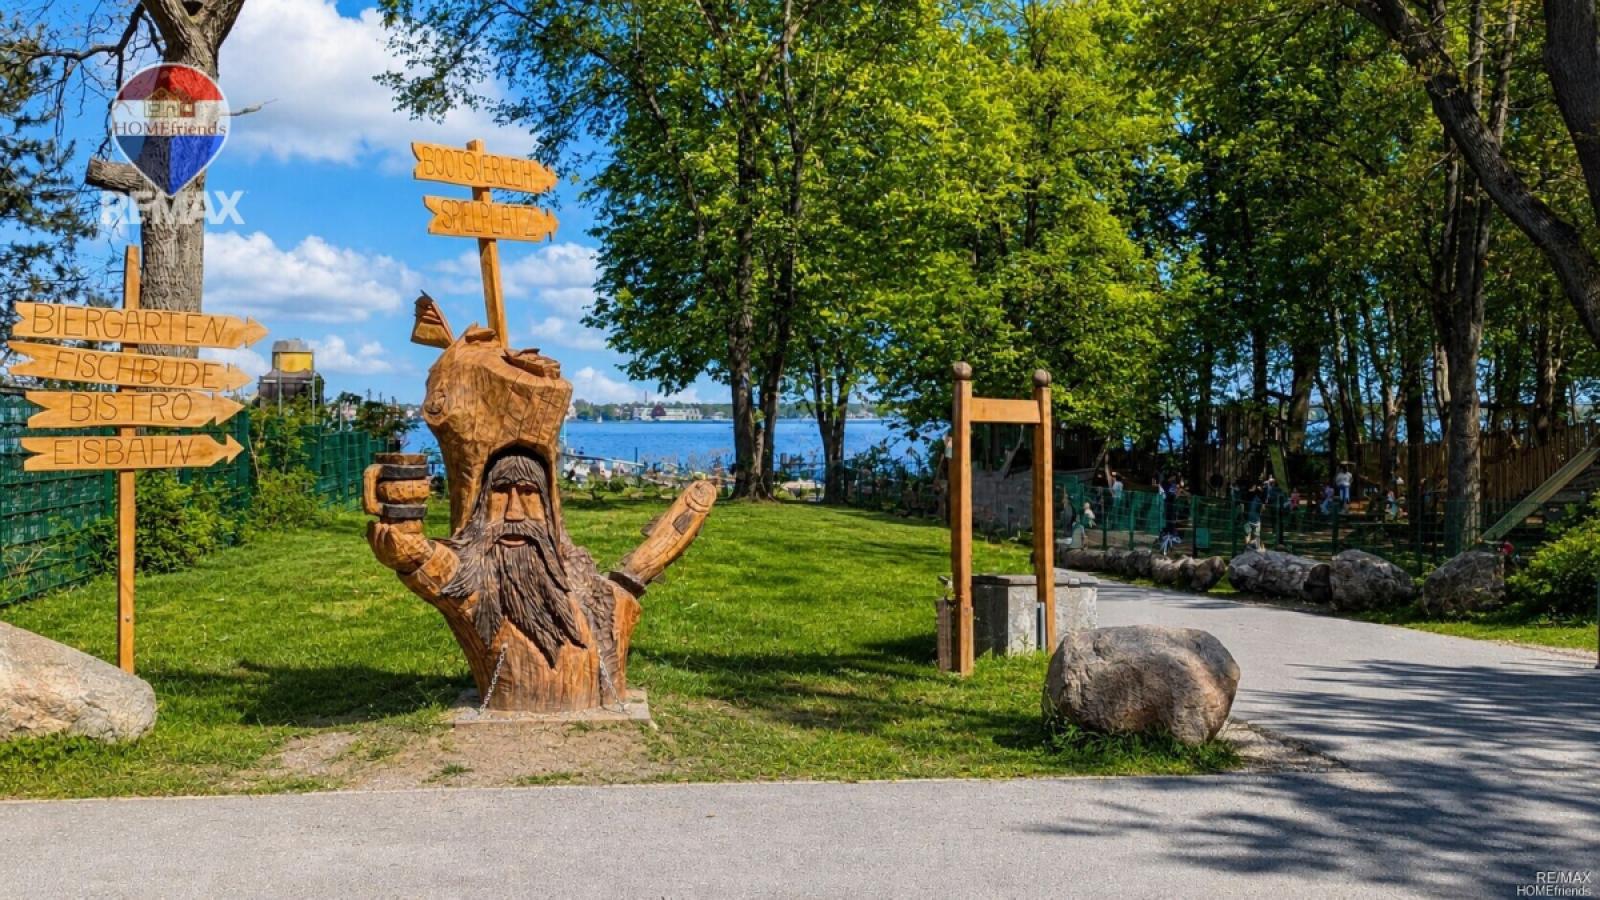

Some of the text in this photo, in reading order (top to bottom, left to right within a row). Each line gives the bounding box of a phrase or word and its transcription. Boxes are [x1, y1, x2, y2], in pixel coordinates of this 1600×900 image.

[422, 146, 533, 188] BOOTSVERLEIH
[32, 303, 228, 344] BIERGARTEN
[53, 350, 222, 389] FISCHBUDE
[69, 392, 193, 422] BISTRO
[54, 438, 194, 465] EISBAHN
